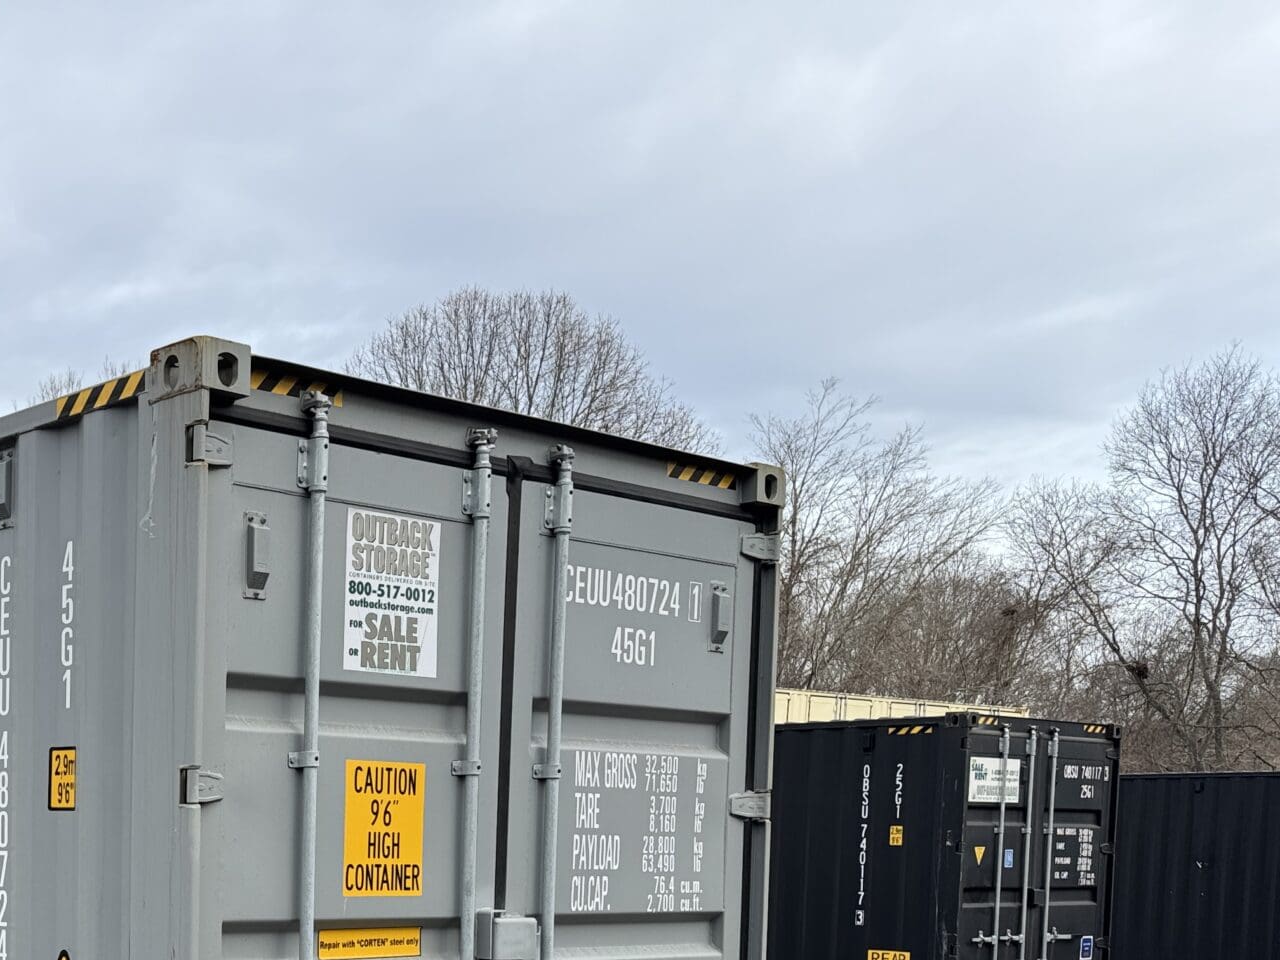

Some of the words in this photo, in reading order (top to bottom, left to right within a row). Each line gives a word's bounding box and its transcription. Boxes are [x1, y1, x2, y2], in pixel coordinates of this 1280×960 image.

[352, 512, 434, 551] OUTBACK
[351, 542, 431, 580] STORAGE
[348, 580, 435, 604] 800-517-0012
[349, 599, 434, 616] outbackstorage.com
[61, 541, 74, 709] 45G1
[349, 619, 363, 629] FOR
[364, 612, 418, 644] SALE
[348, 648, 358, 656] OR
[360, 640, 421, 672] RENT
[611, 626, 656, 667] 45G1
[354, 766, 417, 796] CAUTION
[575, 751, 600, 787] MAX
[604, 752, 637, 789] GROSS
[645, 754, 678, 775] 32,500
[697, 758, 707, 779] kg
[645, 773, 677, 793] 71,650
[696, 776, 704, 794] lb
[895, 763, 904, 818] 25G1
[575, 793, 600, 829] TARE
[649, 796, 677, 815] 3,700
[695, 797, 705, 819] kg
[649, 814, 676, 833] 8,160
[694, 816, 702, 833] lb
[367, 831, 400, 859] HIGH
[572, 834, 620, 870] PAYLOAD
[642, 836, 676, 854] 28,800
[693, 836, 703, 858] kg
[345, 864, 420, 891] CONTAINER
[642, 854, 675, 873] 63,490
[693, 855, 701, 872] lb
[570, 875, 611, 912] CU.CAP.
[654, 876, 674, 894] 76.4
[680, 880, 703, 894] cu.m.
[646, 894, 674, 913] 2,700
[856, 911, 864, 925] 3
[320, 940, 340, 951] Repair
[342, 941, 356, 949] with
[389, 937, 405, 946] steel
[405, 937, 419, 947] only
